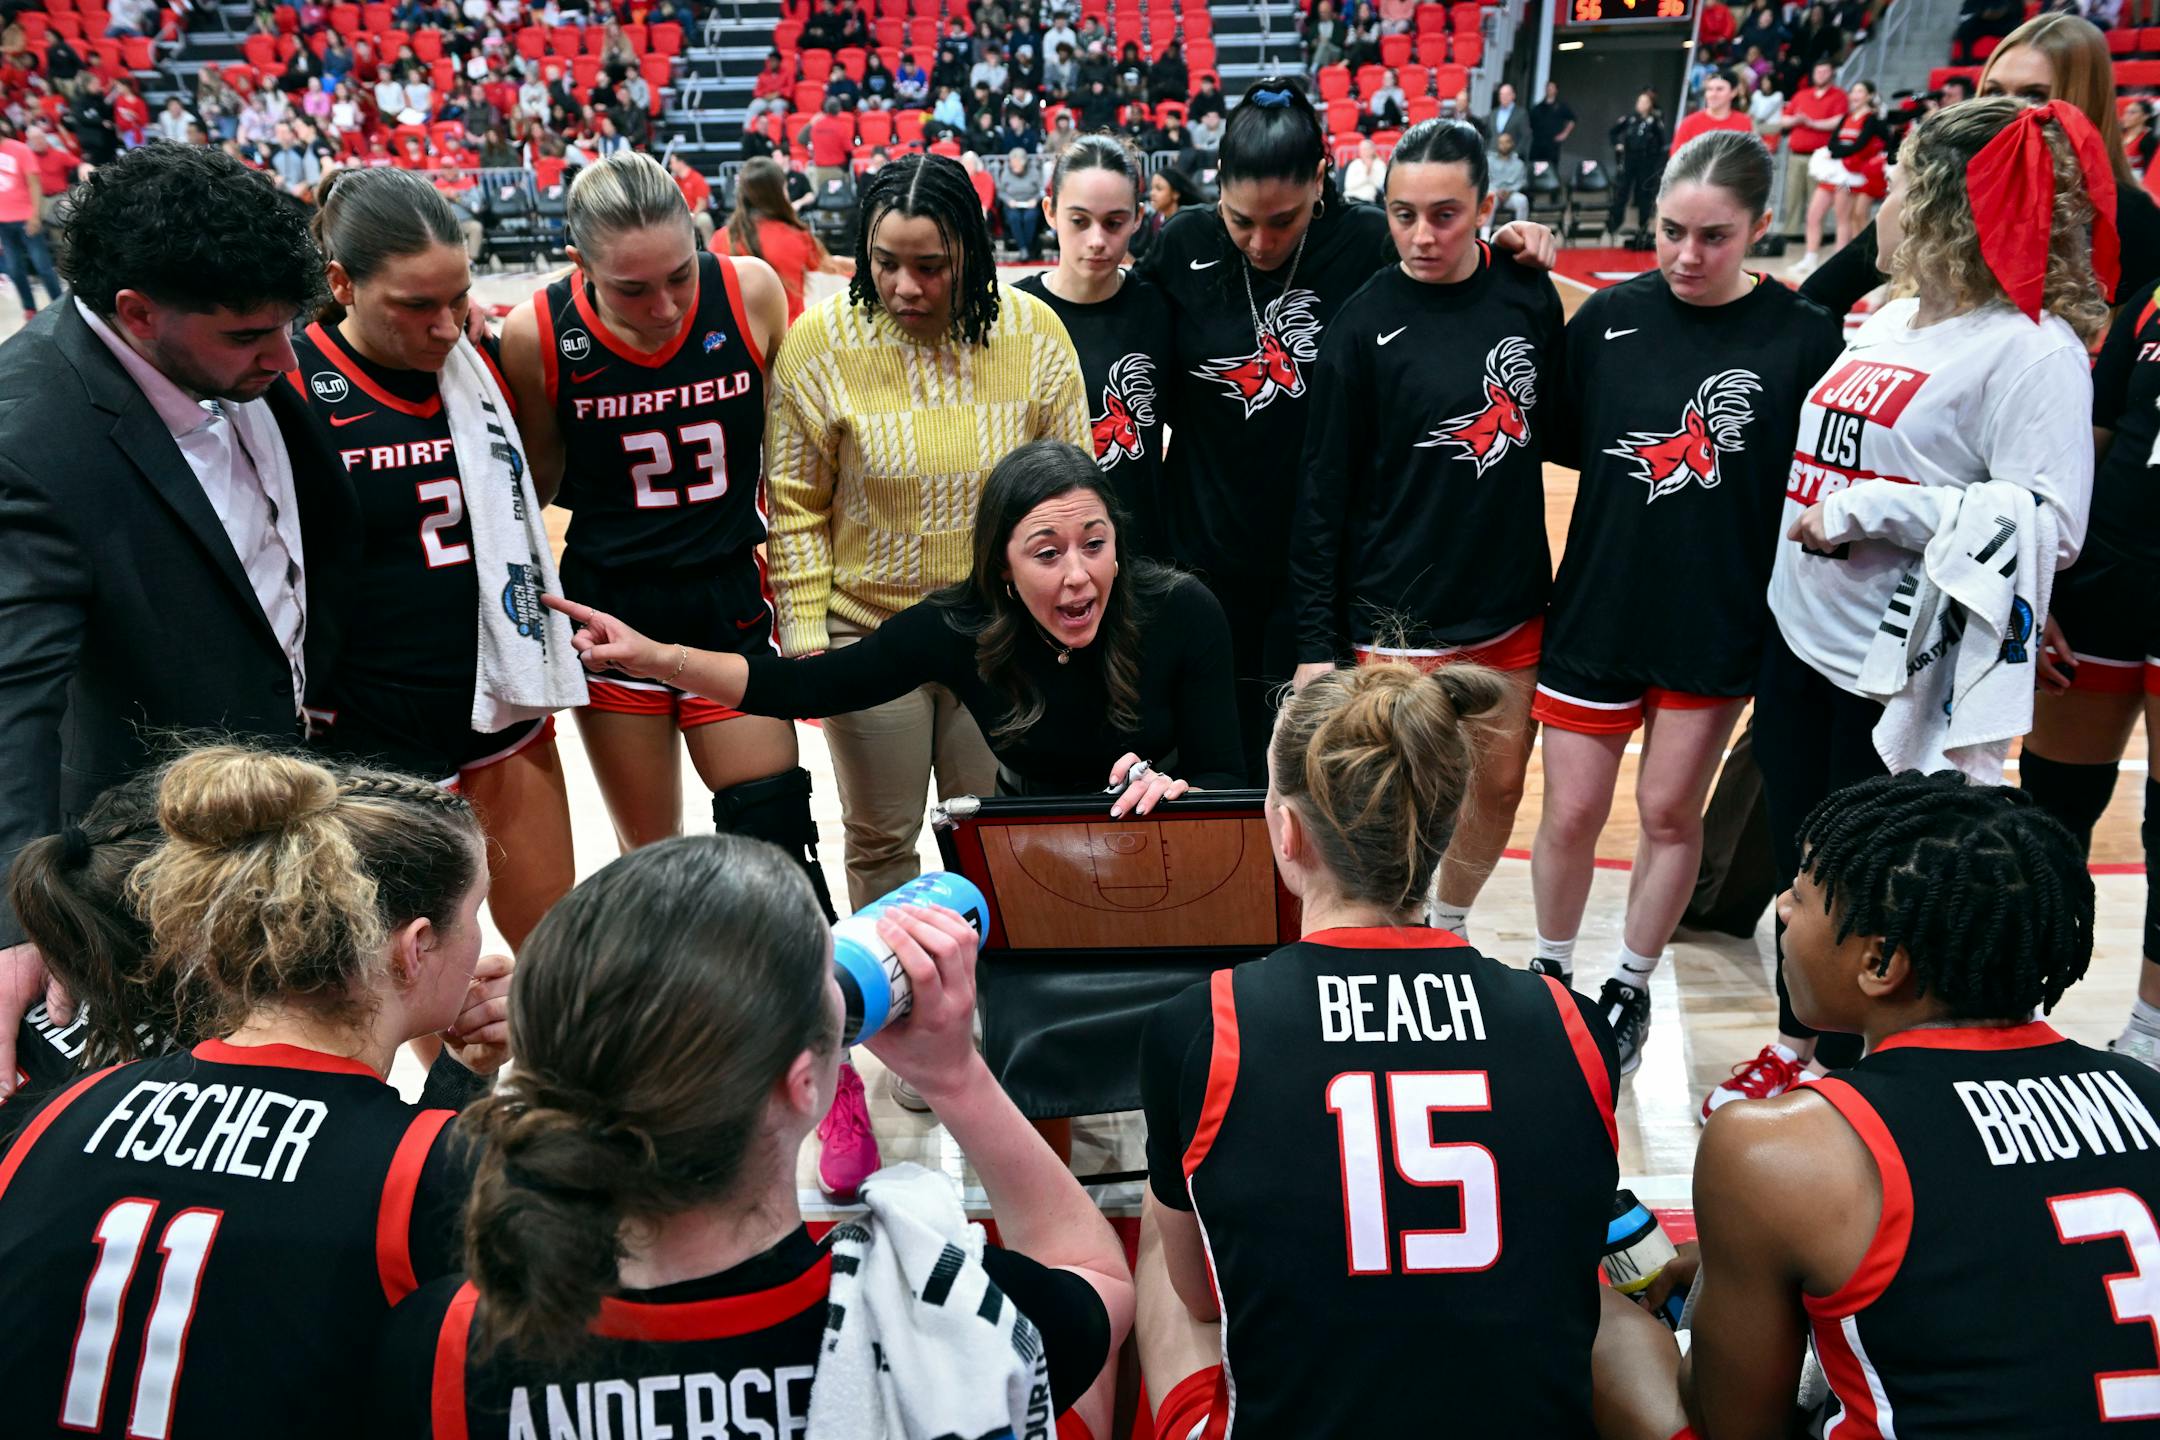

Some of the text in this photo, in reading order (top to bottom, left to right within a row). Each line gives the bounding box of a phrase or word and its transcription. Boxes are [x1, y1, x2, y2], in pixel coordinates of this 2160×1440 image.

[562, 335, 588, 352] BLM
[314, 377, 346, 394] BLM
[572, 370, 751, 420] FAIRFIELD
[1822, 365, 1914, 416] JUST
[339, 437, 453, 473] FAIRF
[620, 419, 729, 509] 23
[1821, 412, 1860, 467] US
[416, 476, 472, 570] 2
[514, 584, 529, 623] MARCH
[1317, 972, 1487, 1042] BEACH
[83, 1080, 329, 1182] FISCHER
[1953, 1070, 2160, 1166] BROWN
[1325, 1070, 1503, 1276] 15
[58, 1196, 225, 1440] 11
[2045, 1187, 2160, 1423] 3
